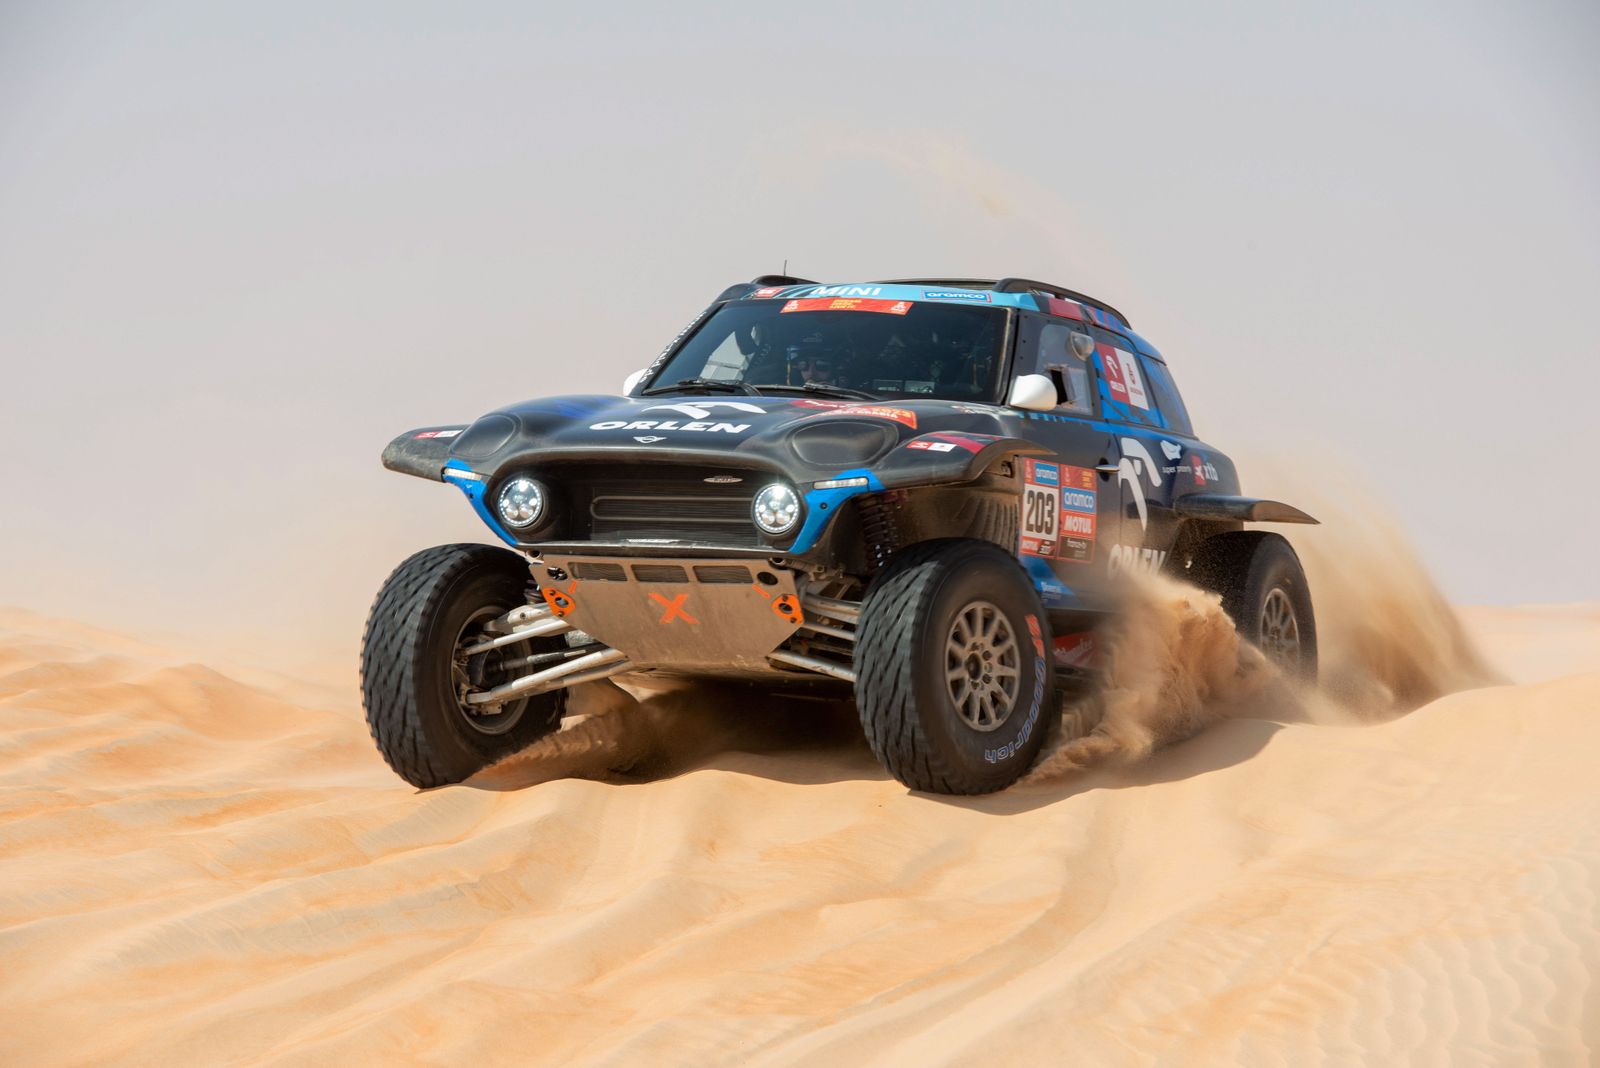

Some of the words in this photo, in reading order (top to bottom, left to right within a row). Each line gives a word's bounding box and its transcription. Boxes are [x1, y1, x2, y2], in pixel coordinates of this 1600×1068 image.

[809, 286, 882, 296] MINI
[588, 420, 752, 435] ORLEN
[1036, 468, 1057, 480] aramco
[1203, 462, 1219, 481] xtb
[1064, 492, 1094, 509] aramco
[1026, 490, 1054, 535] 203
[1064, 515, 1092, 534] MOTUL
